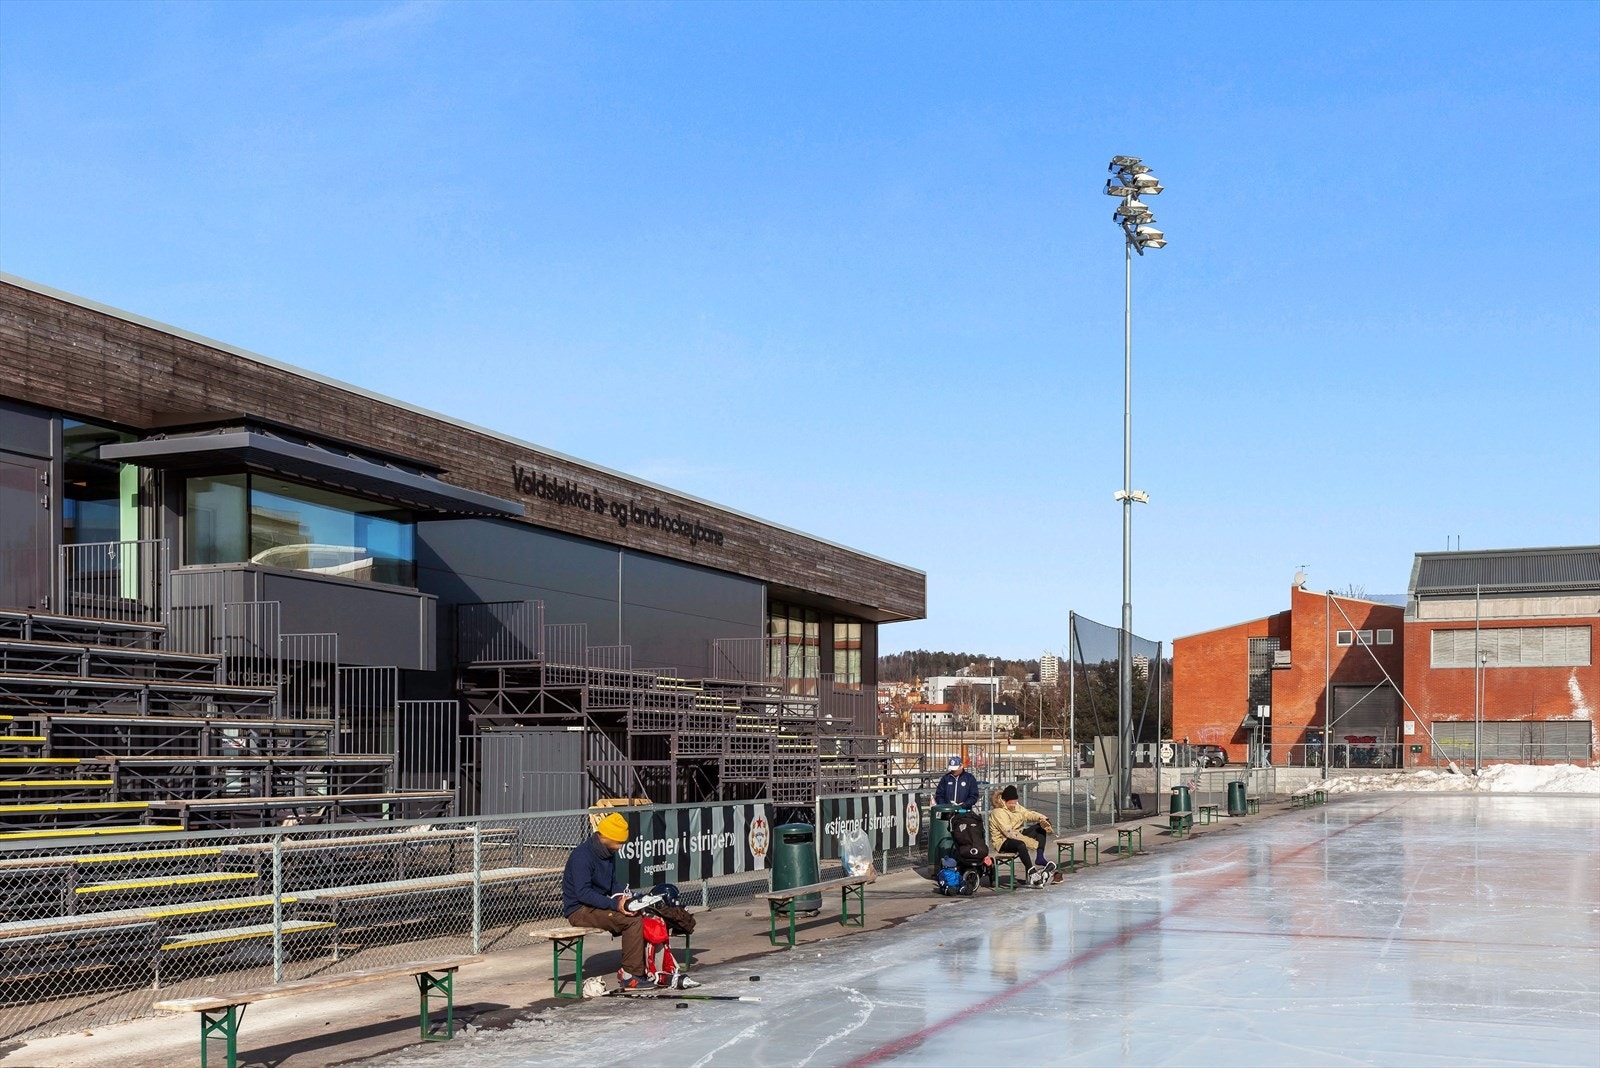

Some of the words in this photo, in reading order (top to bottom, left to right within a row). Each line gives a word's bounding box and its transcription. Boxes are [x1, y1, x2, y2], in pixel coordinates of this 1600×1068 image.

[511, 464, 591, 511] Voldsløkka
[610, 501, 628, 528] og
[630, 500, 724, 546] landhockeybane
[864, 813, 868, 831] i
[683, 831, 687, 854] i
